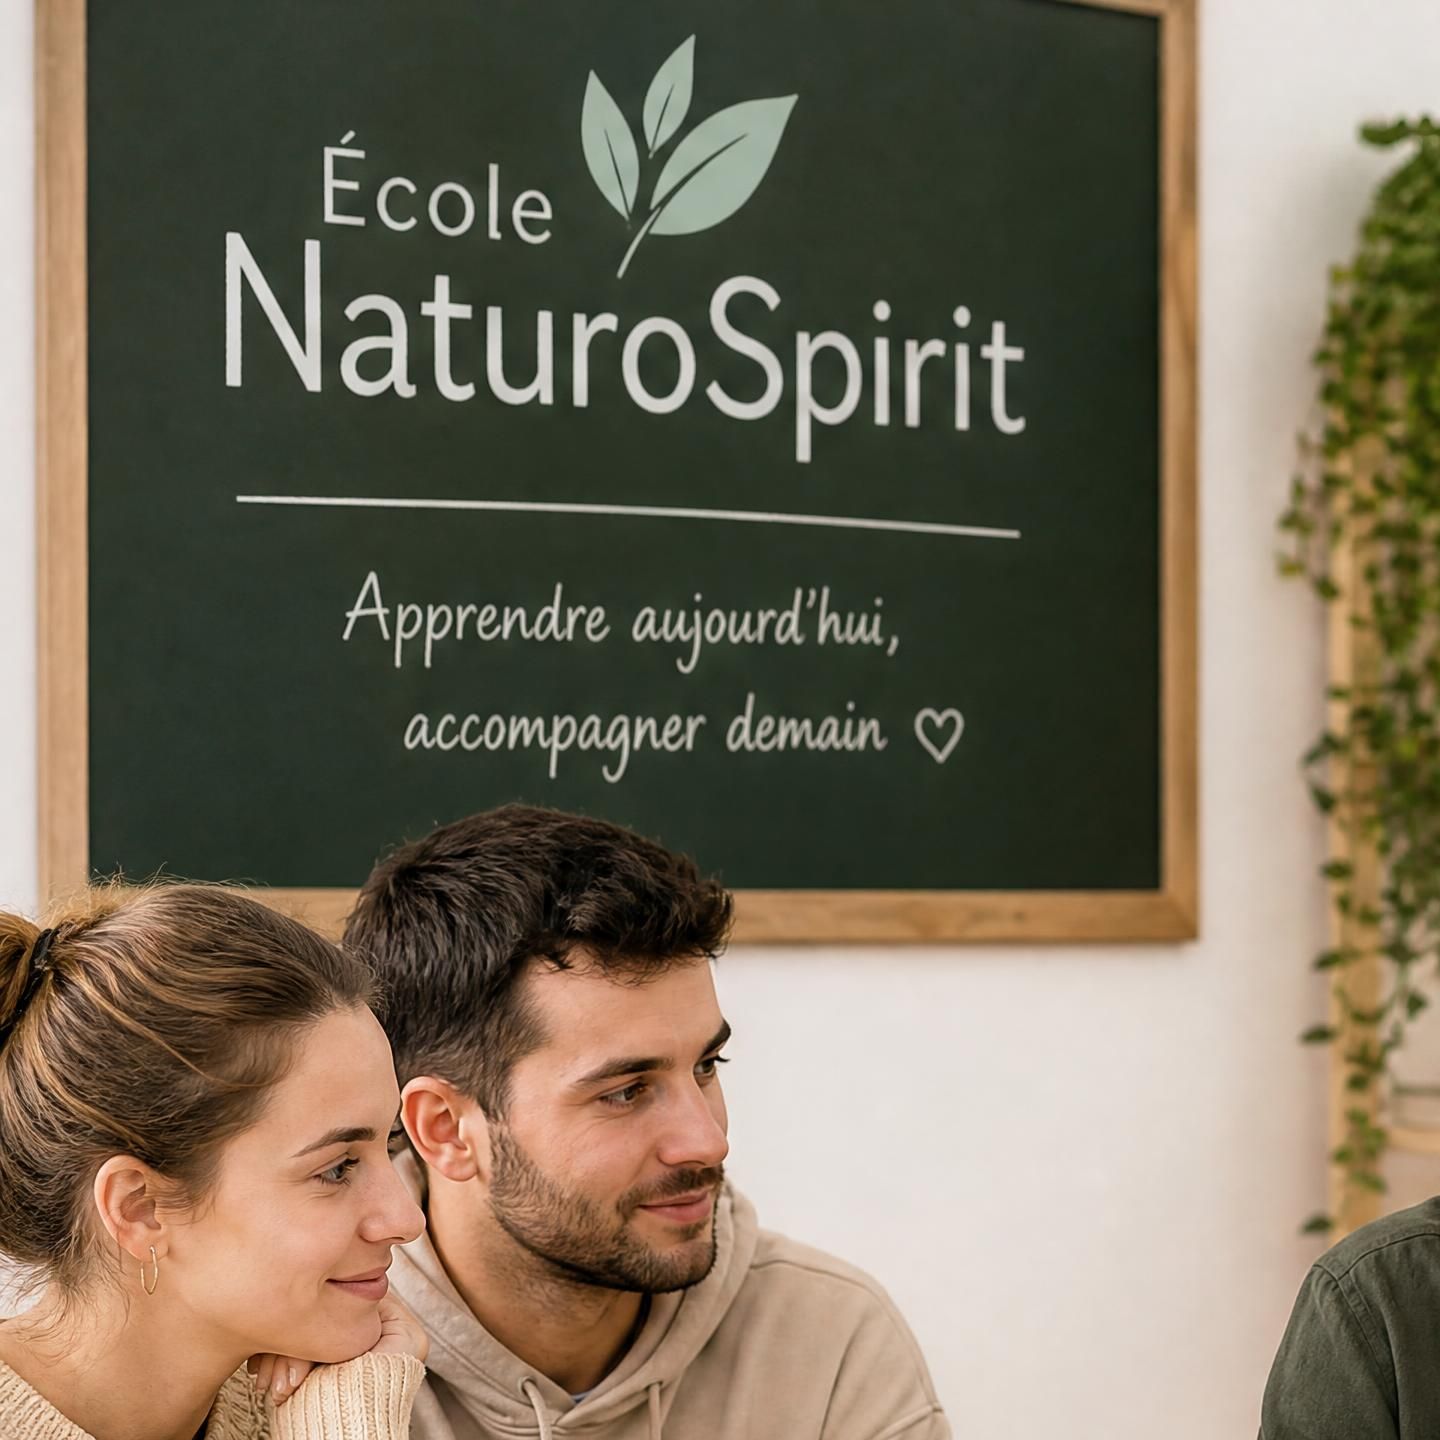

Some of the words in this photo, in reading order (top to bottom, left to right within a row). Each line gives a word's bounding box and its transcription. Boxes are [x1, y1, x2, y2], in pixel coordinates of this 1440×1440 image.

[322, 131, 552, 243] École
[226, 231, 1024, 462] NaturoSpirit
[343, 572, 609, 667] Apprendre
[404, 712, 705, 782] accompagner
[727, 693, 886, 751] demain
